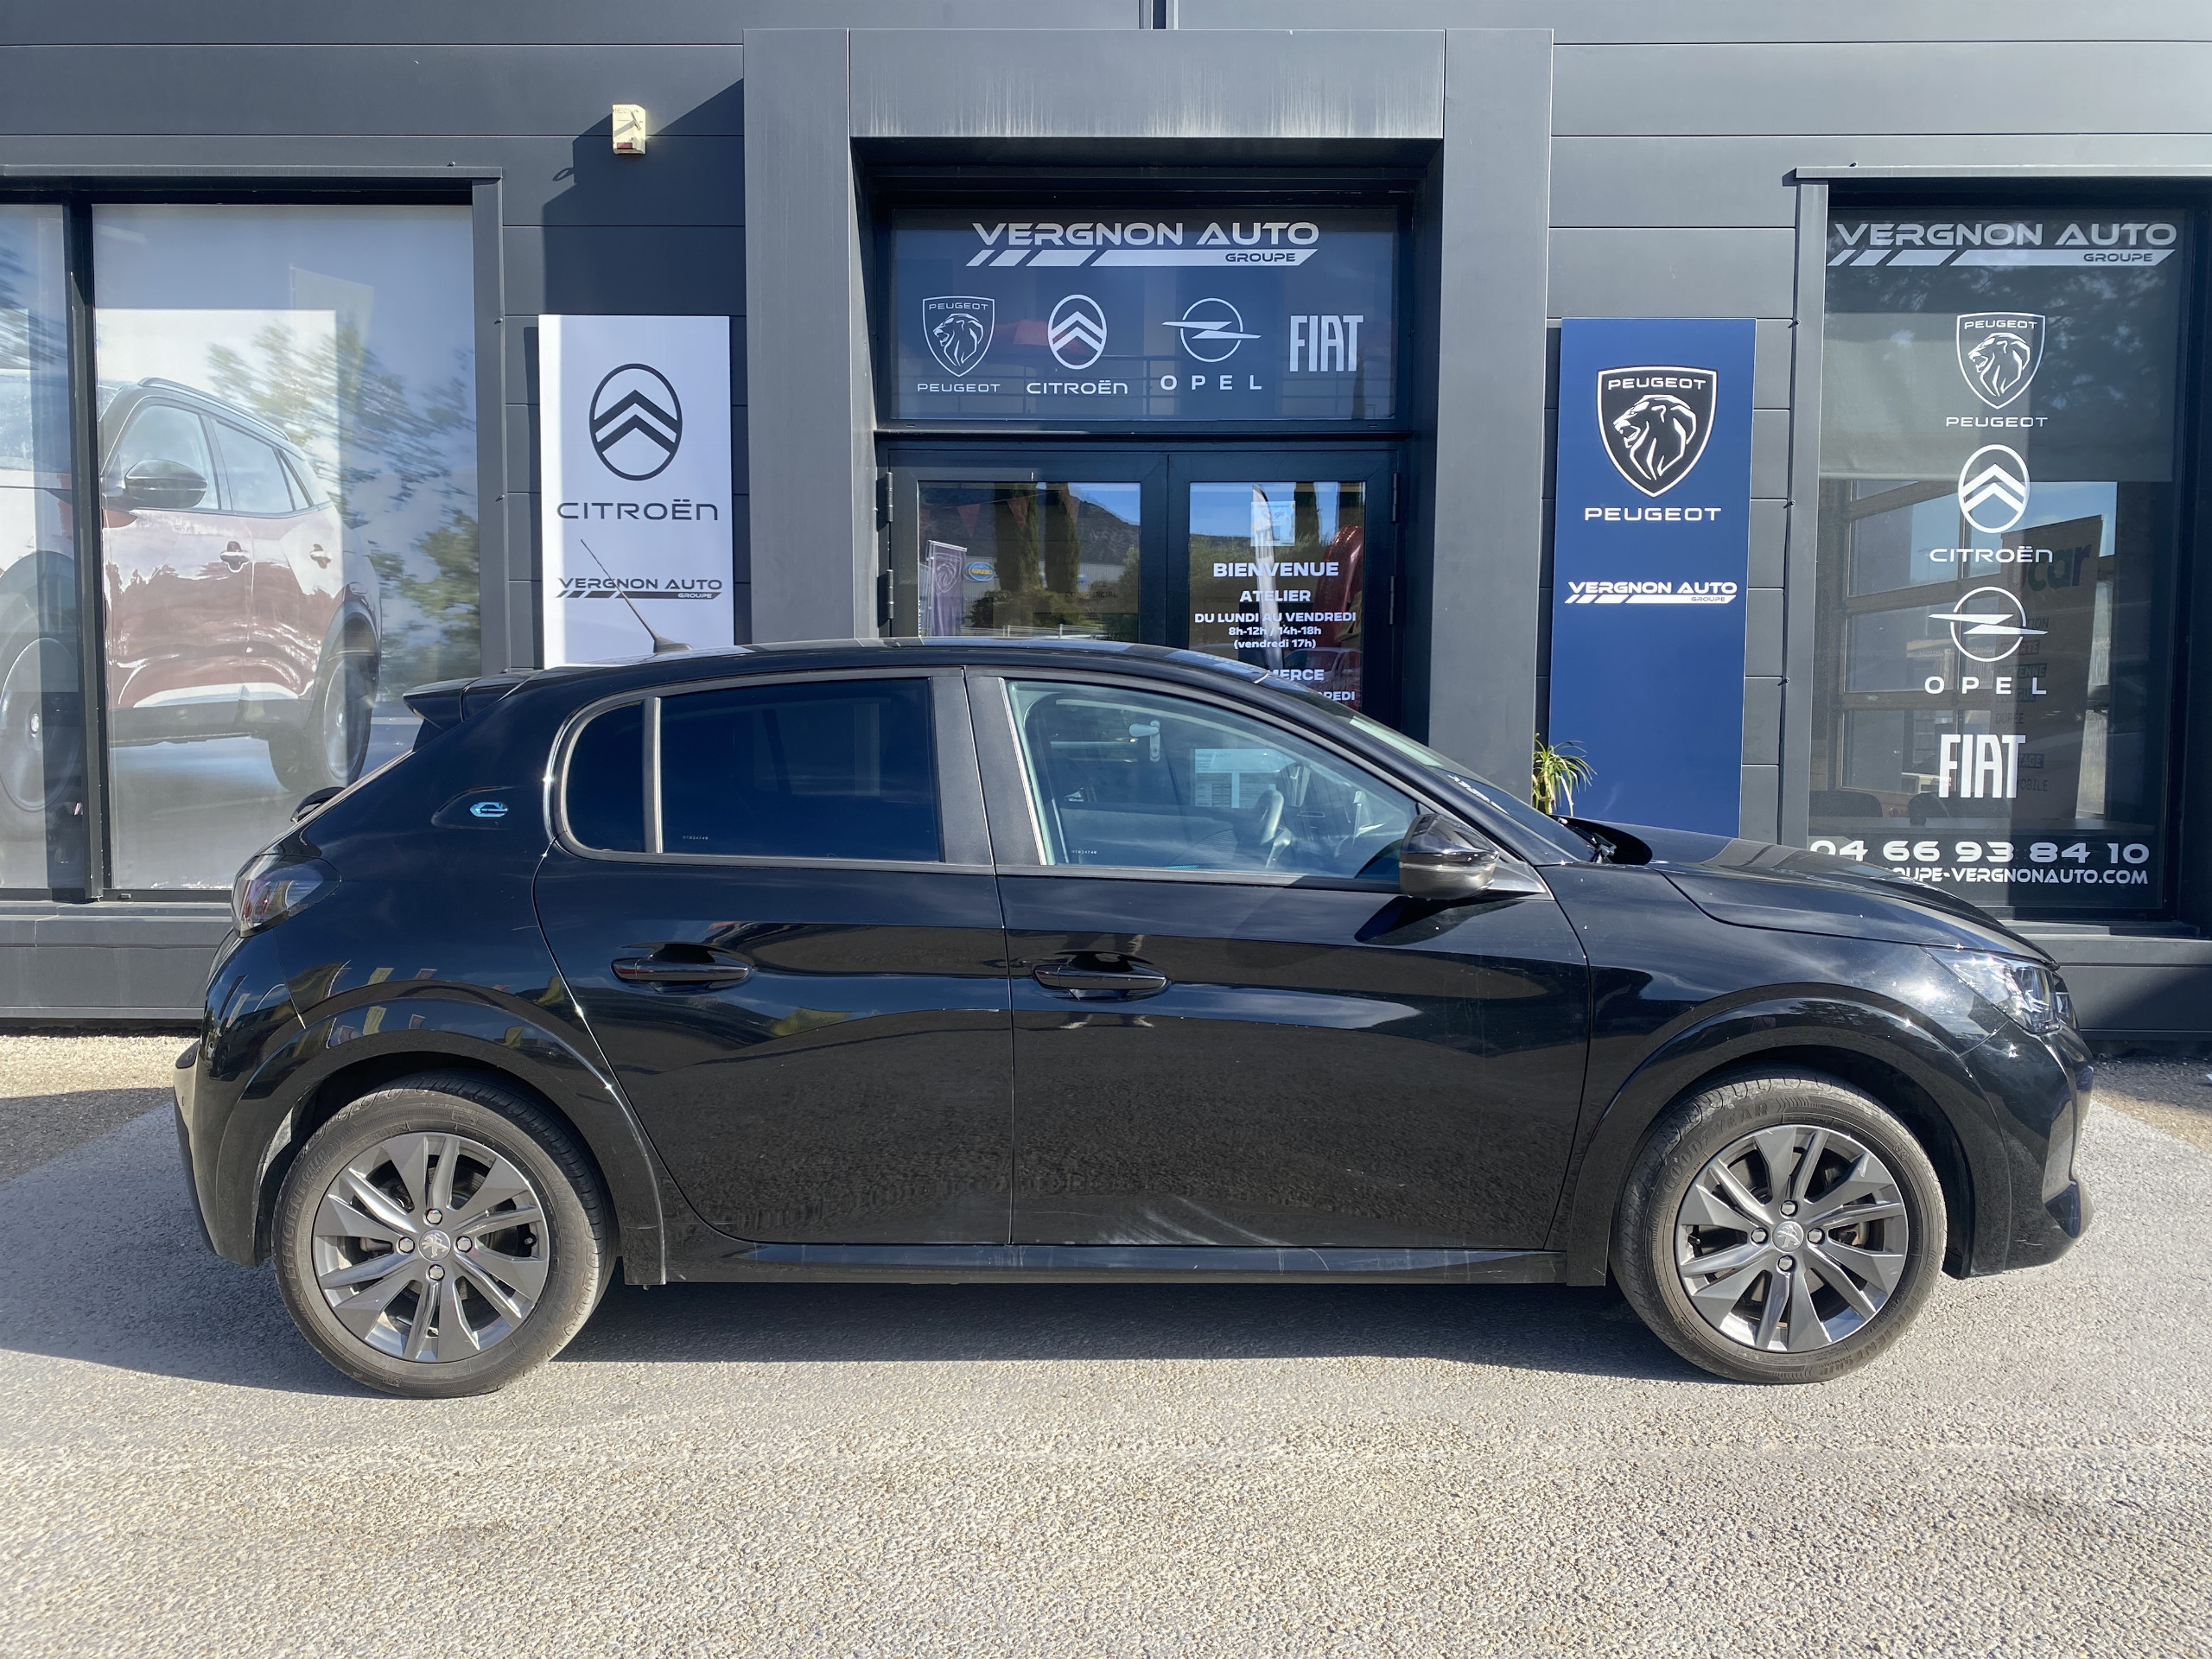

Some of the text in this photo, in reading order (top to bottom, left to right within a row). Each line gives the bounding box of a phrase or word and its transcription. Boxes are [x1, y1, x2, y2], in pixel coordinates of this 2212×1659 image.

[972, 222, 1319, 245] VERGNON AUTO
[1835, 223, 2177, 246] VERGNON AUTO
[1225, 252, 1296, 263] GROUPE
[2083, 252, 2153, 263] GROUPE
[929, 302, 988, 311] PEUGEOT
[1964, 320, 2037, 330] PEUGEOT
[1289, 315, 1363, 372] FIAT
[917, 383, 1001, 392] PEUGEOT
[1160, 375, 1262, 391] OPEL
[1608, 378, 1707, 390] PEUGEOT
[1946, 416, 2048, 428] PEUGEOT
[1585, 507, 1721, 521] PEUGEOT
[1213, 562, 1338, 578] BIENVENUE
[557, 577, 722, 590] VERGNON AUTO
[1568, 582, 1738, 594] VERGNON AUTO
[1240, 589, 1311, 603] ATELIER
[1195, 612, 1357, 623] DU LUNDI AU VENDREDI
[1228, 626, 1267, 636] 8h-12h
[1278, 626, 1321, 636] 14h-18h
[1234, 639, 1317, 650] (vendredi 17h)
[1924, 677, 2047, 695] OPEL
[1938, 734, 2026, 798] FIAT
[1809, 840, 2150, 863] 04 66 93 84 10
